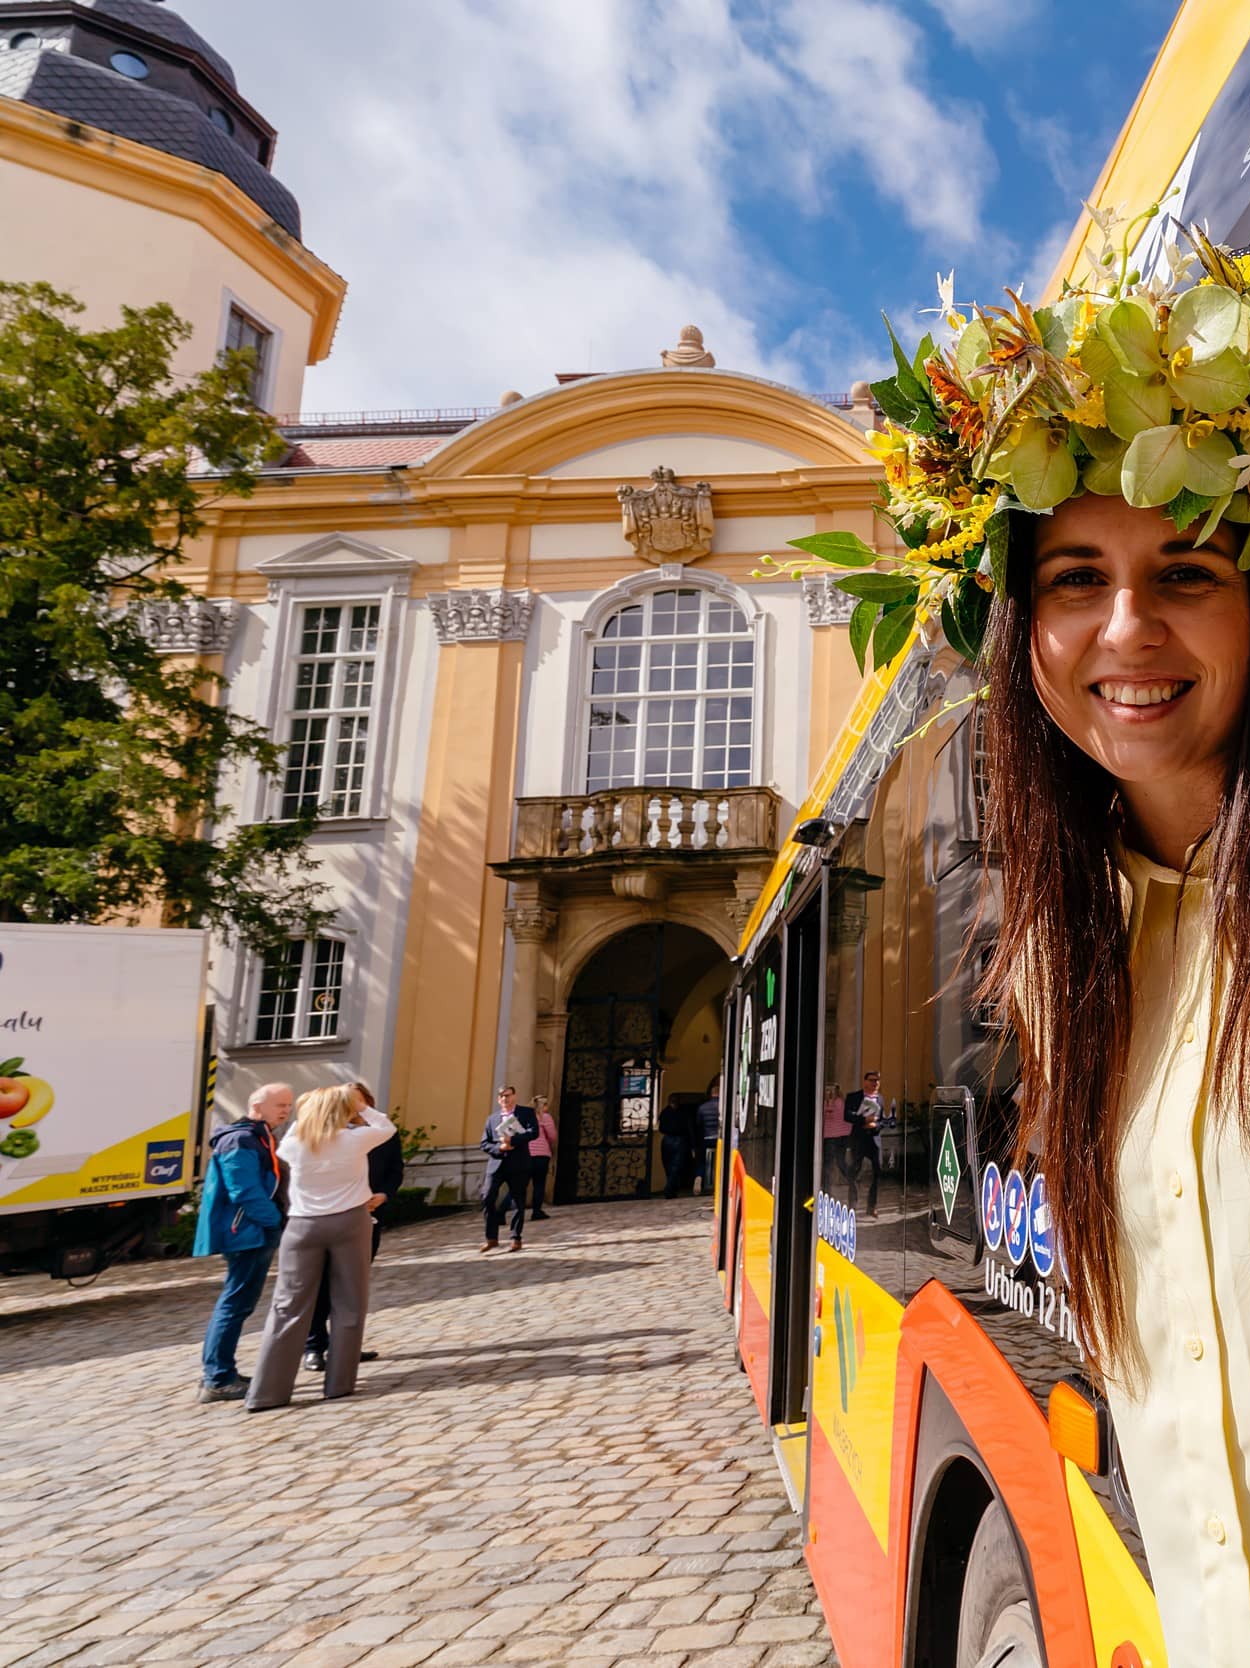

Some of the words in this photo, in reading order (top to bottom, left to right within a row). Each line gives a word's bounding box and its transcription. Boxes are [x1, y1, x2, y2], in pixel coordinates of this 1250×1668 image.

[760, 1014, 777, 1062] ZERO
[943, 1174, 955, 1194] GAS
[985, 1257, 1034, 1318] Urbino
[1037, 1281, 1056, 1333] 12
